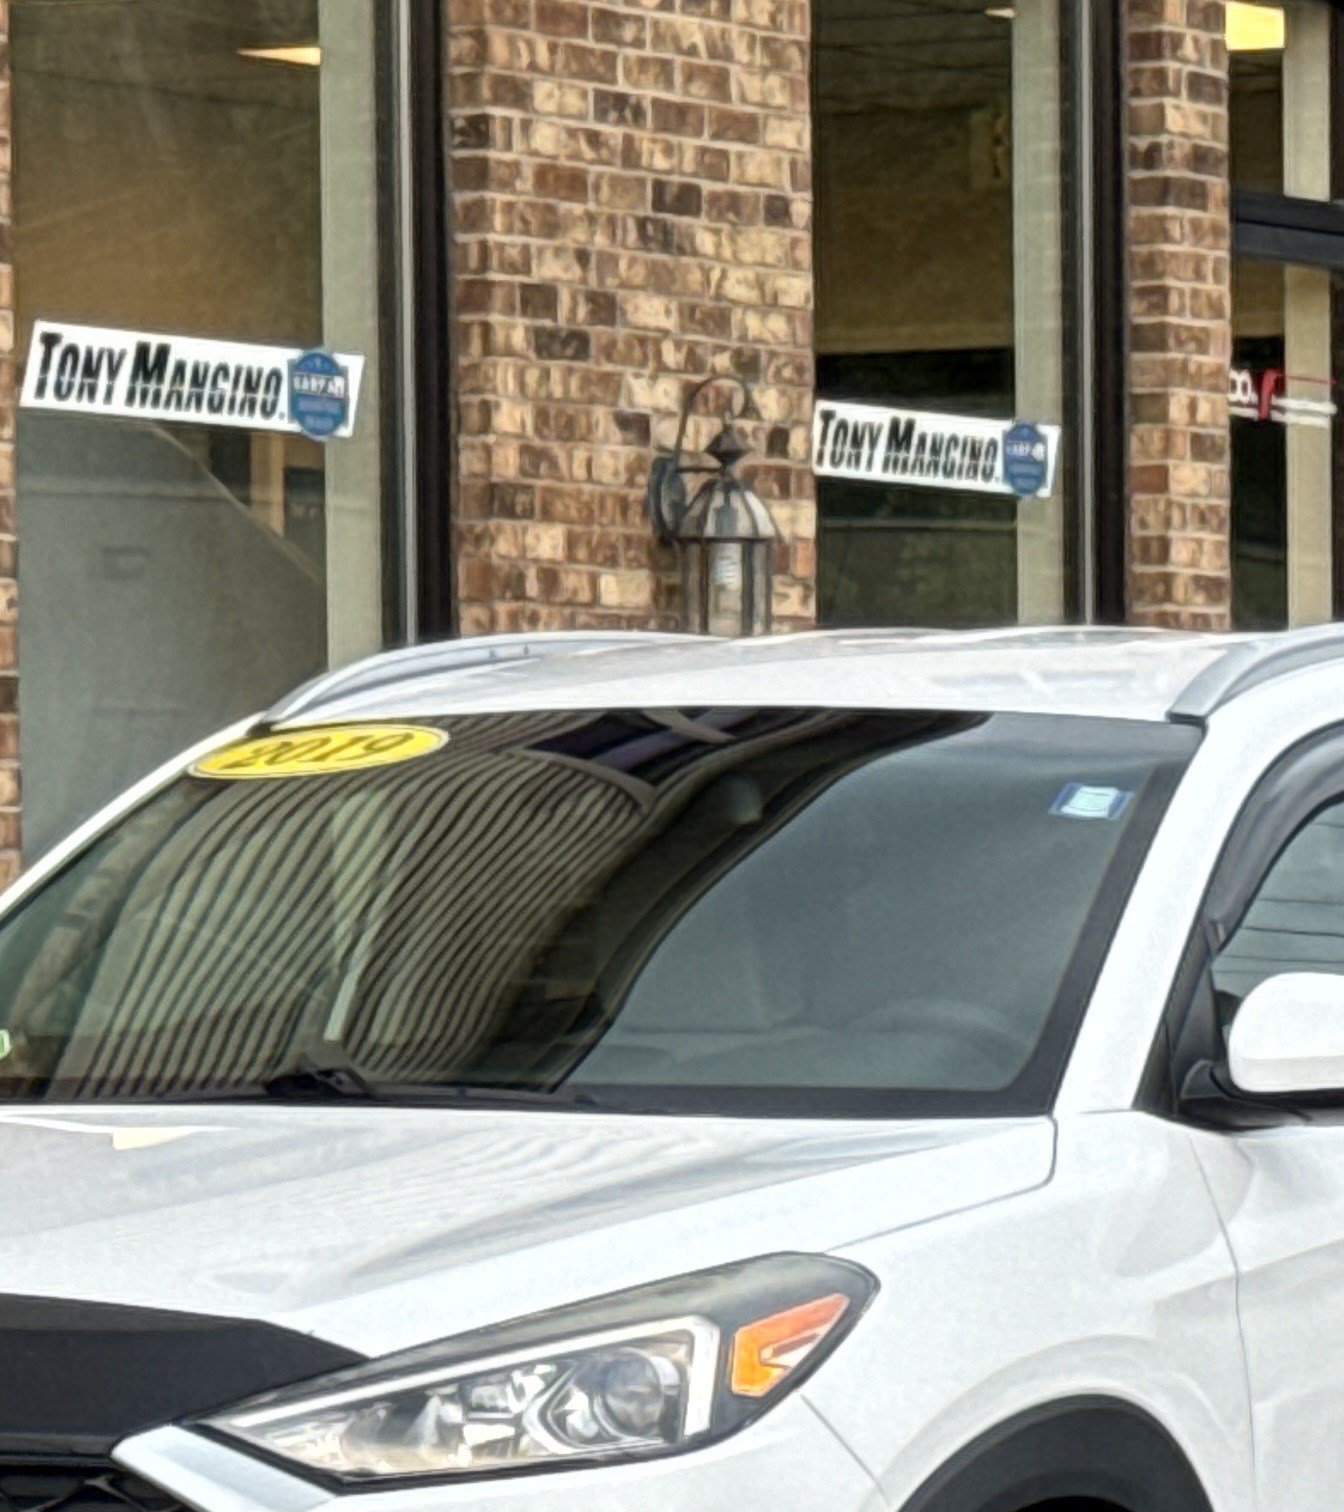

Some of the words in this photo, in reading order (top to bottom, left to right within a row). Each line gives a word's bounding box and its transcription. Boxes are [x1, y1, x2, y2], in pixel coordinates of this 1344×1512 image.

[34, 331, 128, 407] TONY
[815, 409, 884, 473] TONY
[218, 732, 414, 770] 2019
